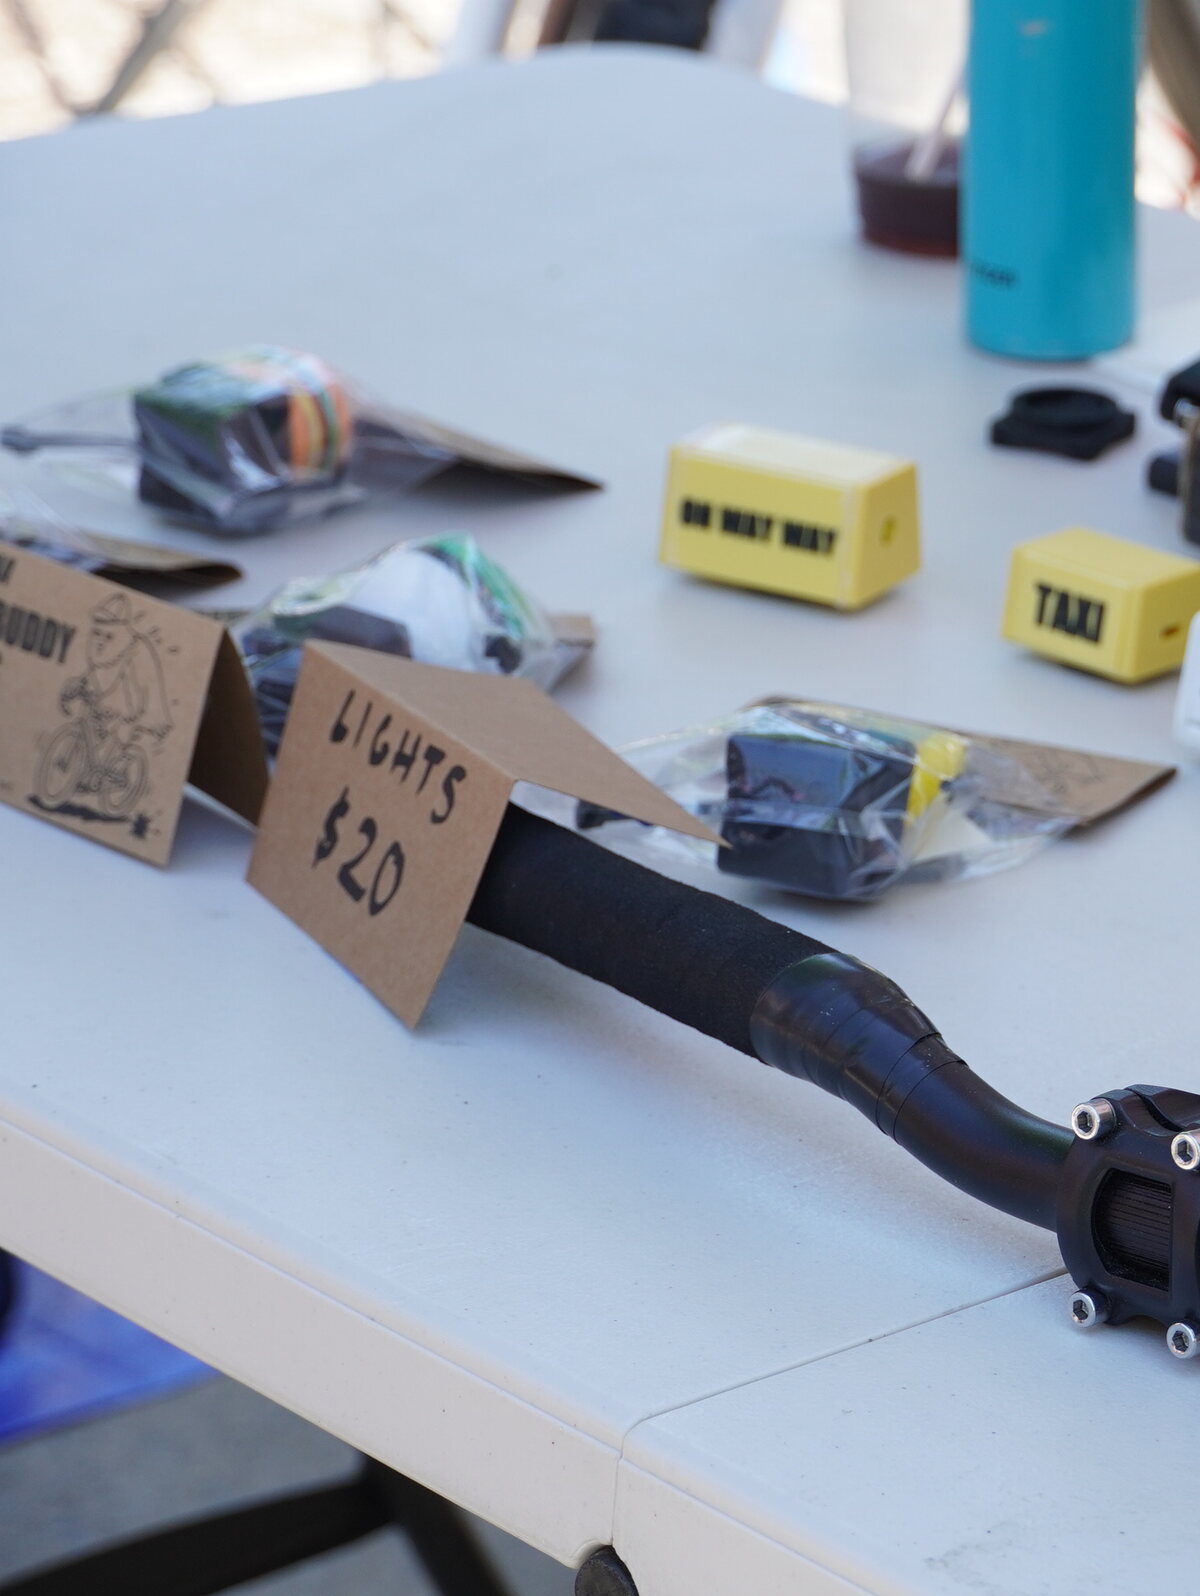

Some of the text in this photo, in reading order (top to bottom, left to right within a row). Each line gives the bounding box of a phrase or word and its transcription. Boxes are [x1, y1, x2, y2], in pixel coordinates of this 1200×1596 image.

[1036, 582, 1105, 643] TAXI
[329, 690, 468, 825] LIGHTS
[312, 785, 407, 917] $20
